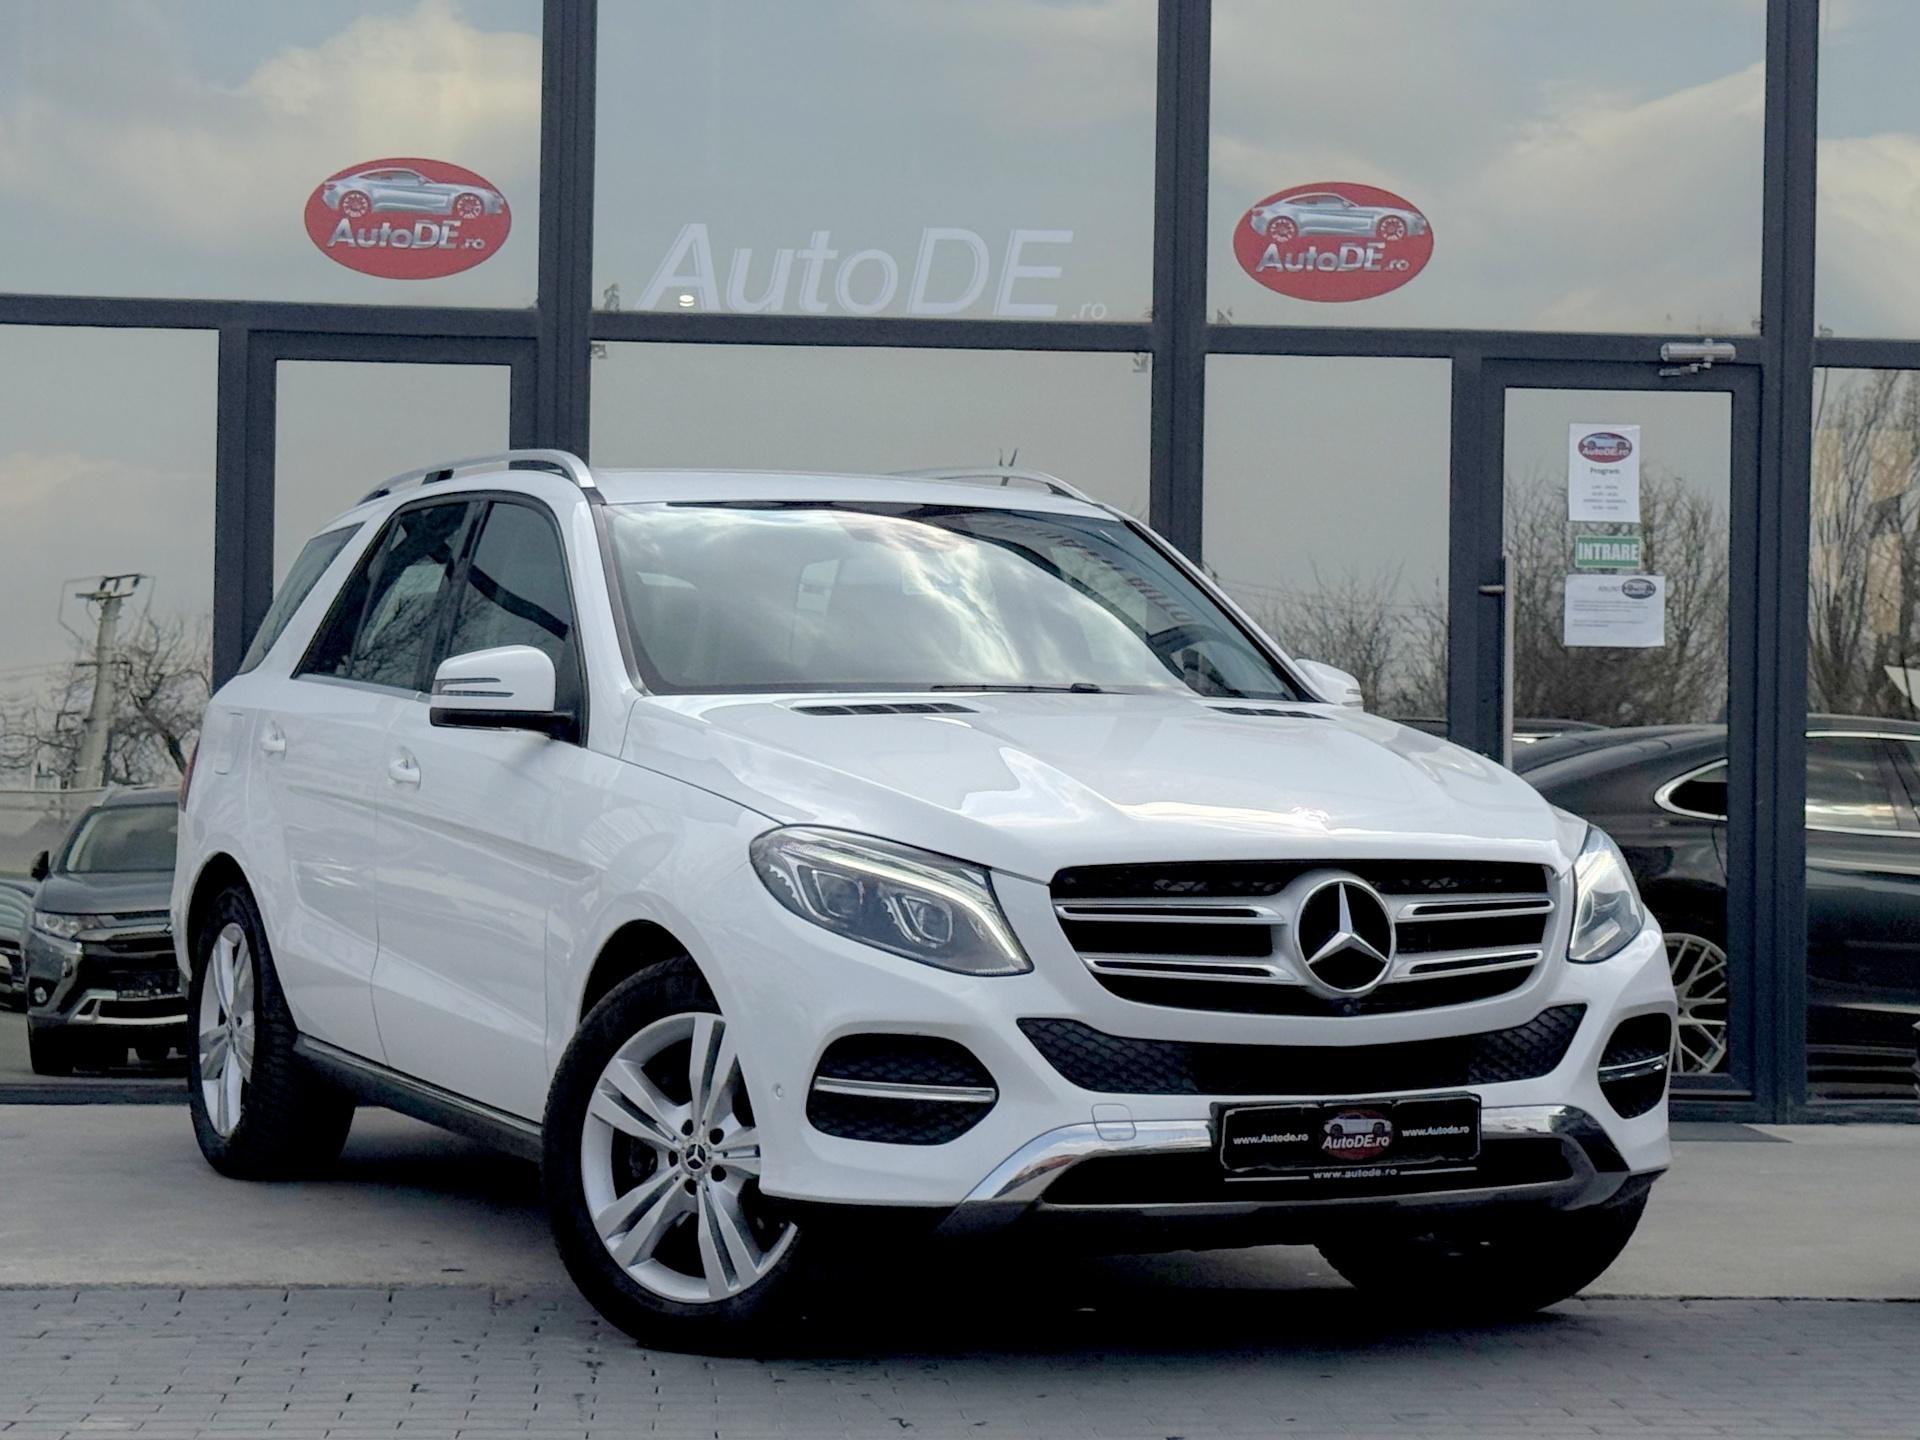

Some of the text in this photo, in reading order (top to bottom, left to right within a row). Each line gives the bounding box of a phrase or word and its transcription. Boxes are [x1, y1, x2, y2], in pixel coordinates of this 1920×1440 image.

[1577, 542, 1639, 561] INTRARE
[1401, 1124, 1471, 1138] www.Autode.ro
[1232, 1132, 1310, 1146] www.Autode.ro
[1321, 1132, 1391, 1151] AutoDE.ro
[1312, 1166, 1399, 1180] www.autode.ro
